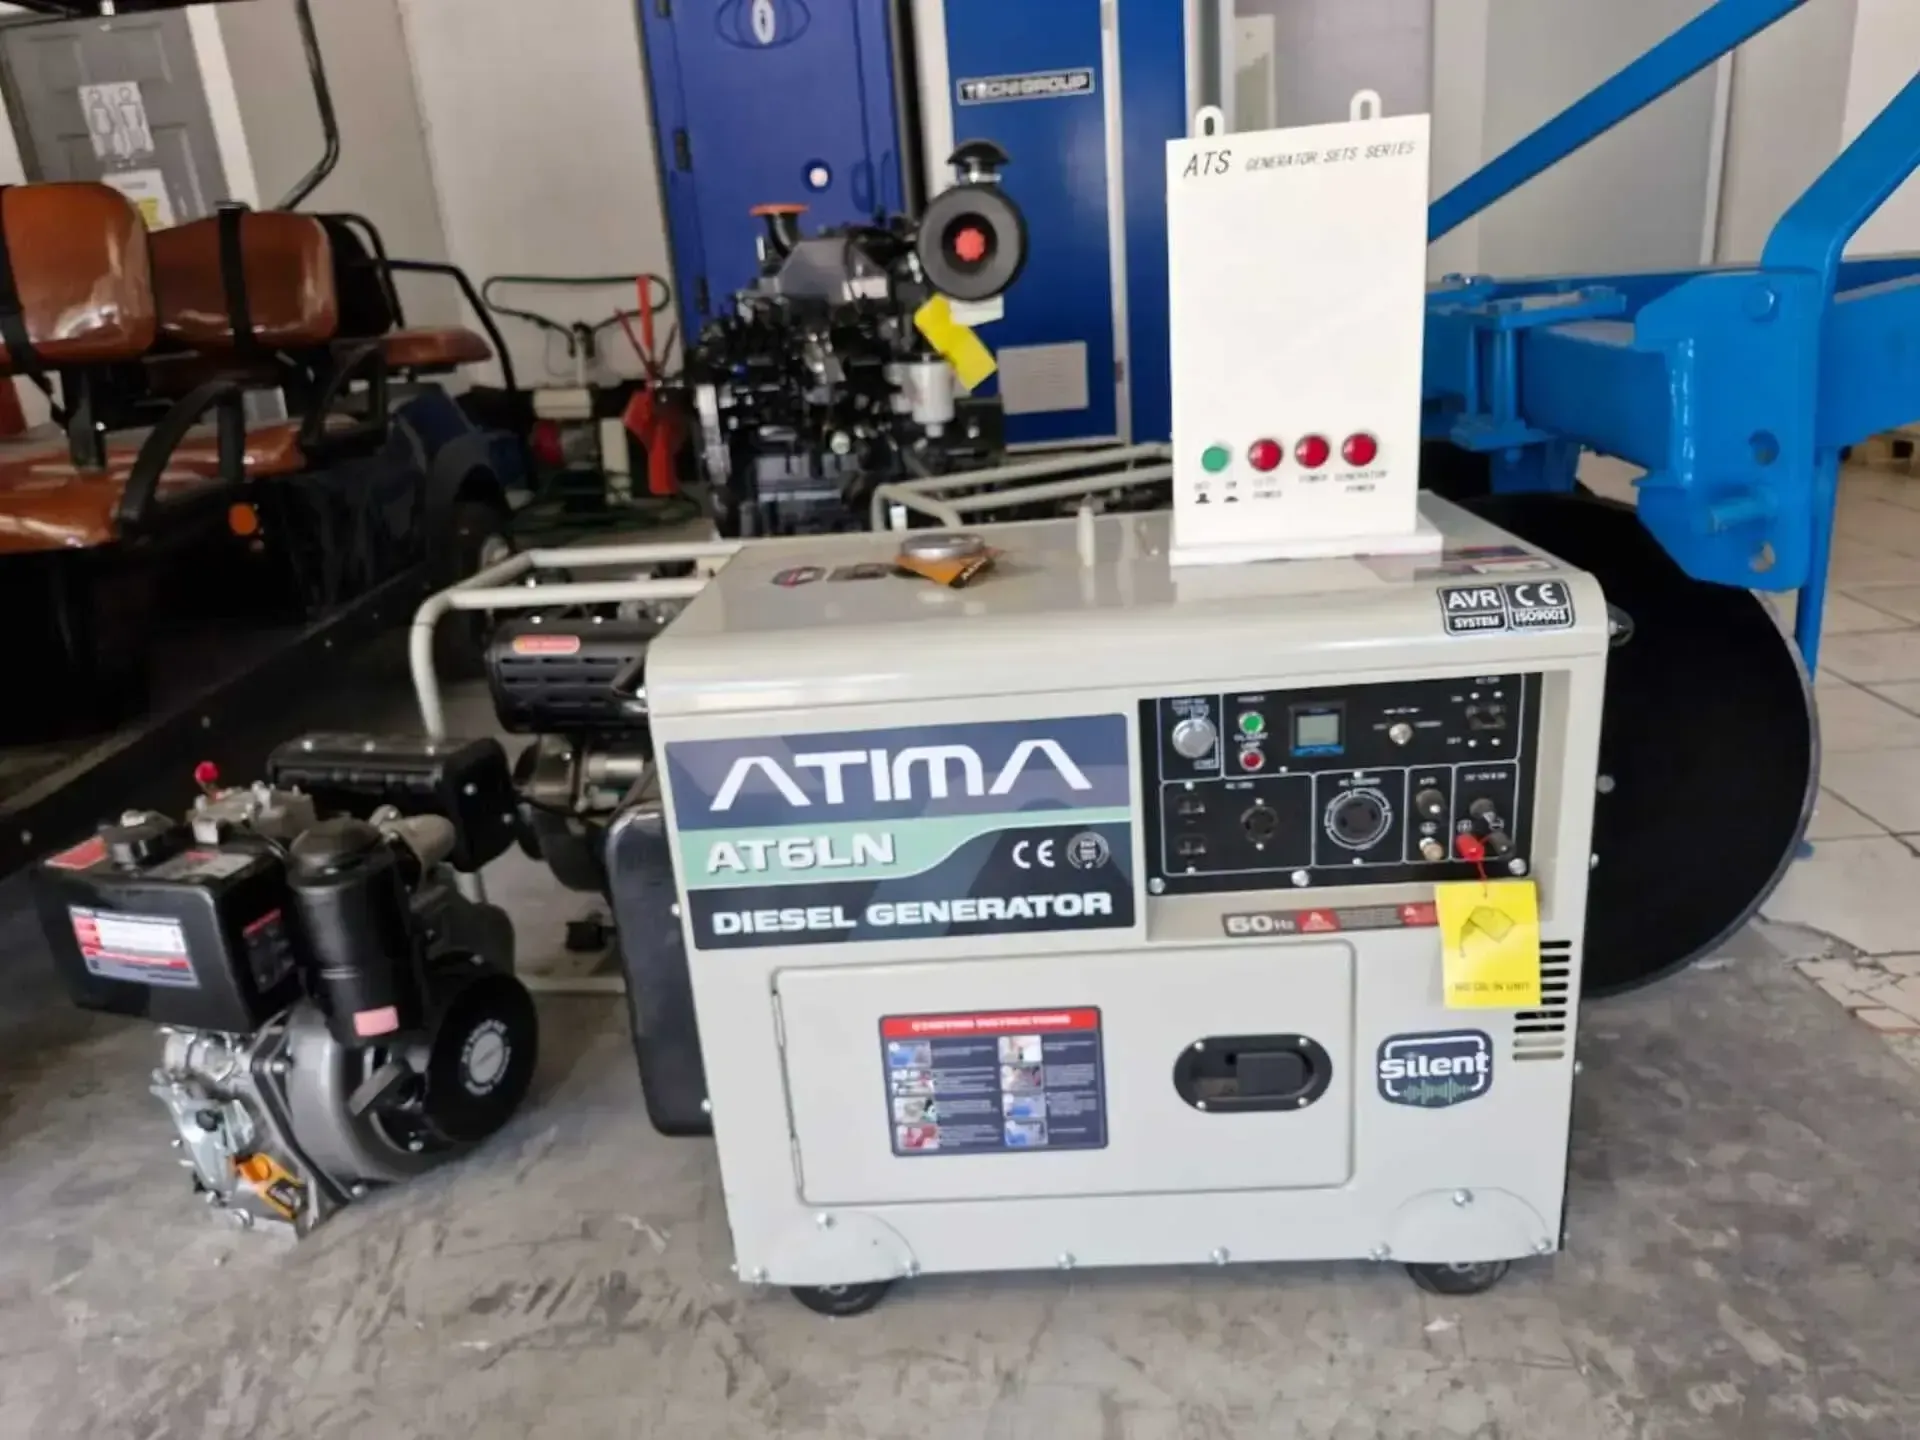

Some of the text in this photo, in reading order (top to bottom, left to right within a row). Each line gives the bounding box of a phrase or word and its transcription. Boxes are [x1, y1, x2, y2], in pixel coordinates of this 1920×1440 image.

[1183, 140, 1416, 178] ATS GENERATOR SETS SERIES
[1448, 588, 1500, 609] AVR
[1515, 582, 1558, 606] CE
[1454, 615, 1499, 629] SYSTEM
[709, 738, 1093, 812] ATIMA
[705, 832, 895, 875] AT6LN
[1012, 838, 1056, 870] CE
[712, 891, 1113, 936] DIESEL GENERATOR
[1379, 1051, 1490, 1080] Silent
